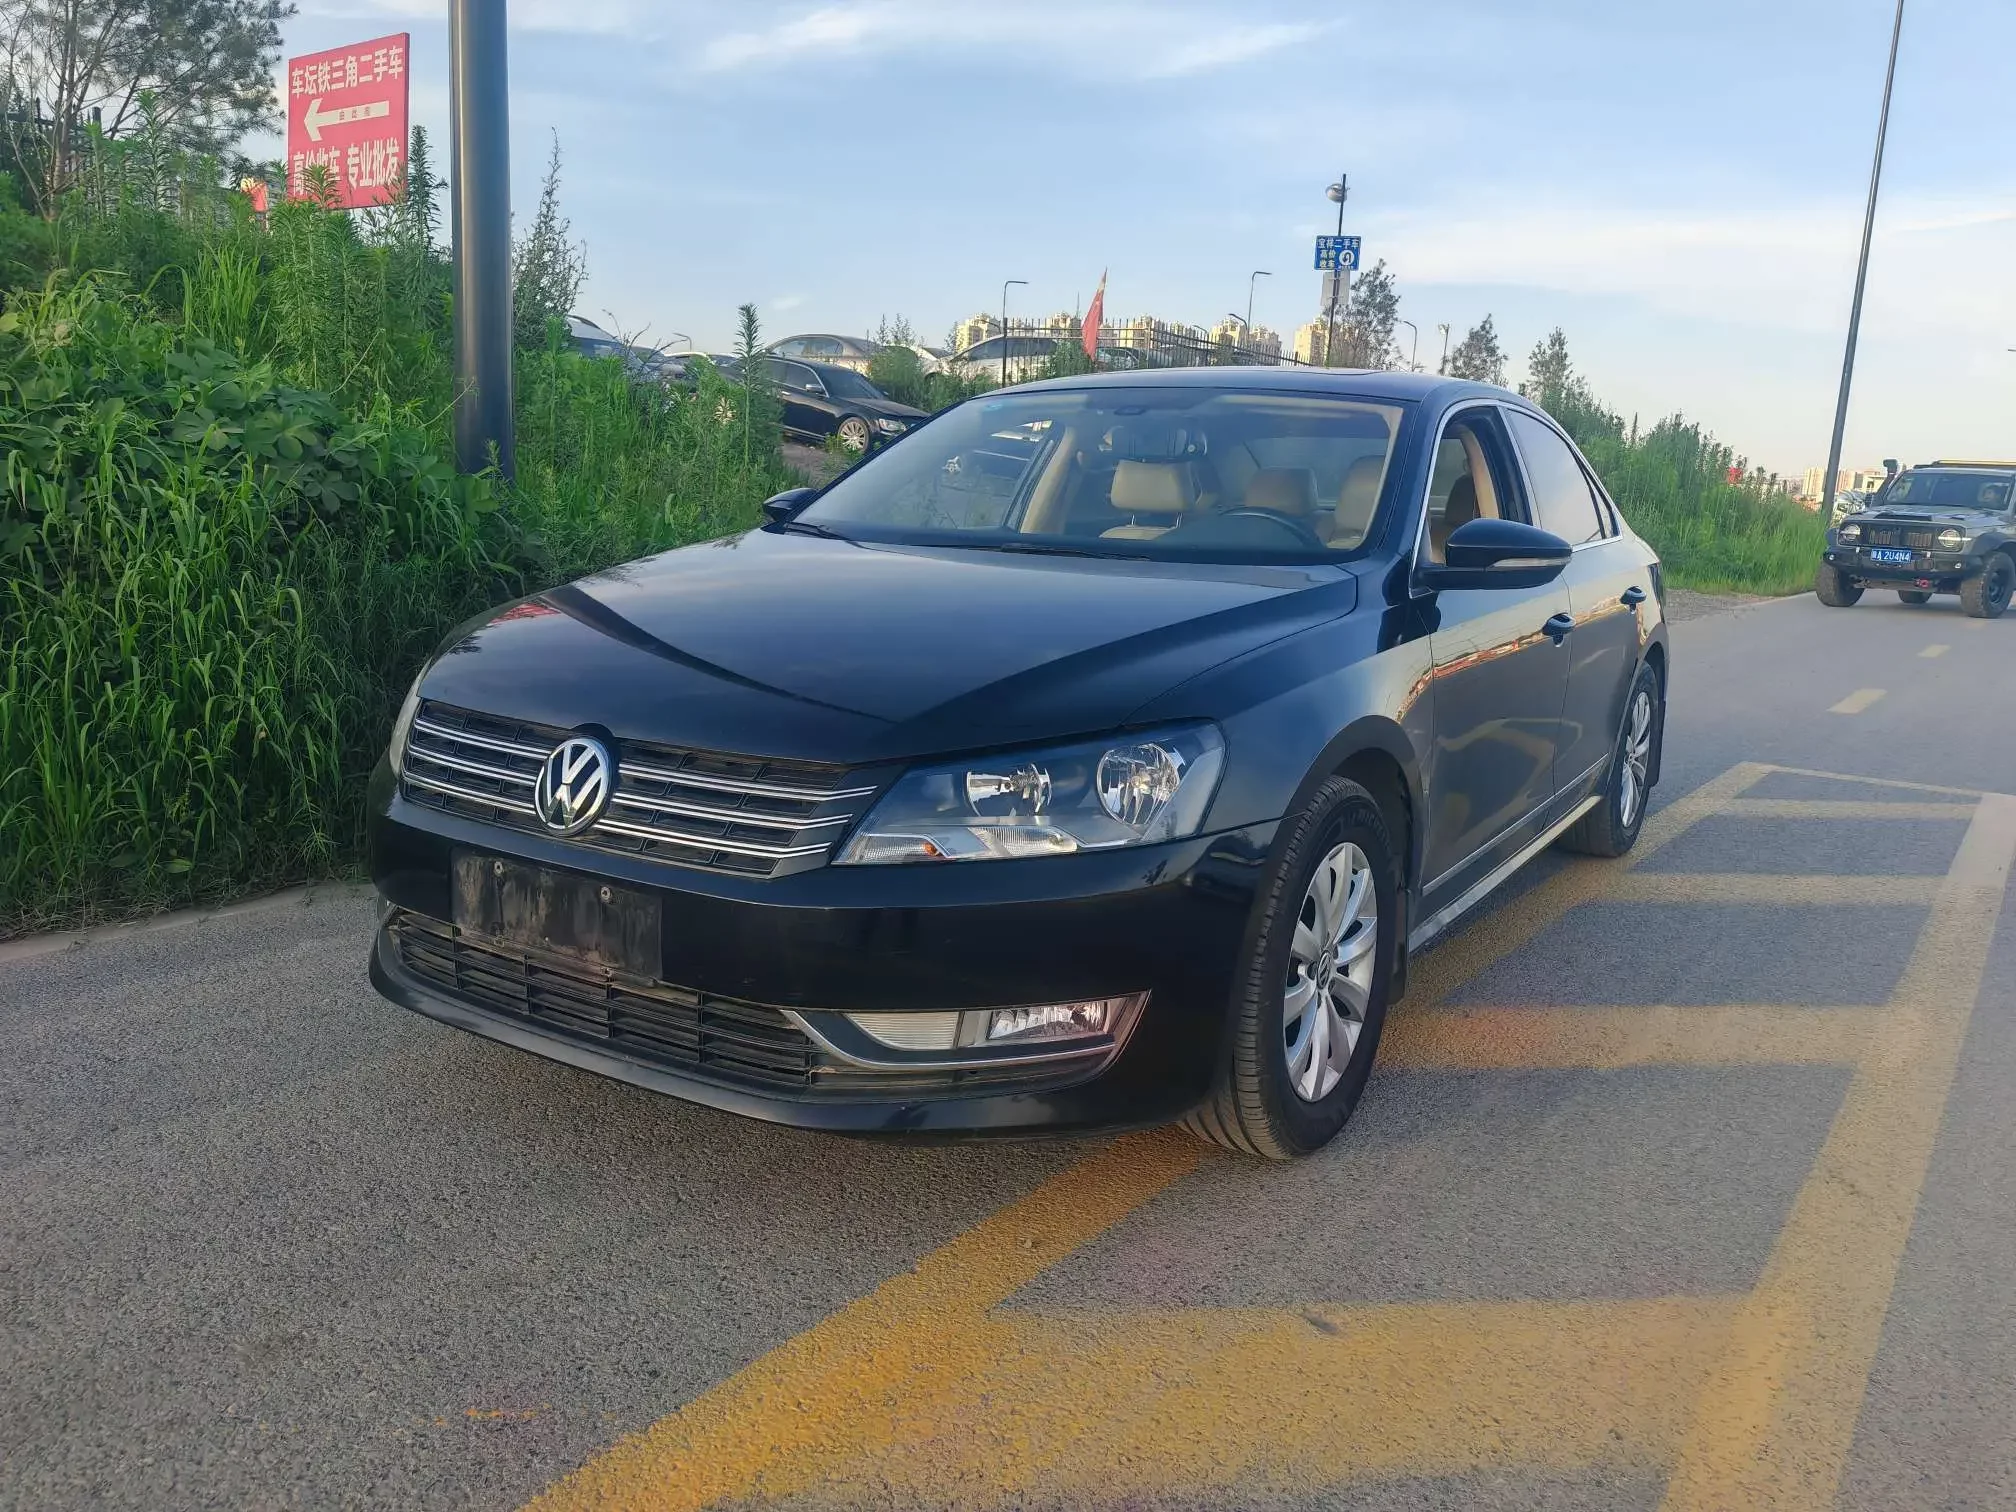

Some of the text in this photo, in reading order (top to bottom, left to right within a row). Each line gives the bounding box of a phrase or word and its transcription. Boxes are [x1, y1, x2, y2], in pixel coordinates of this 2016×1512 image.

[291, 45, 404, 99] 车坛铁三角二手车
[347, 137, 400, 190] 专业批发
